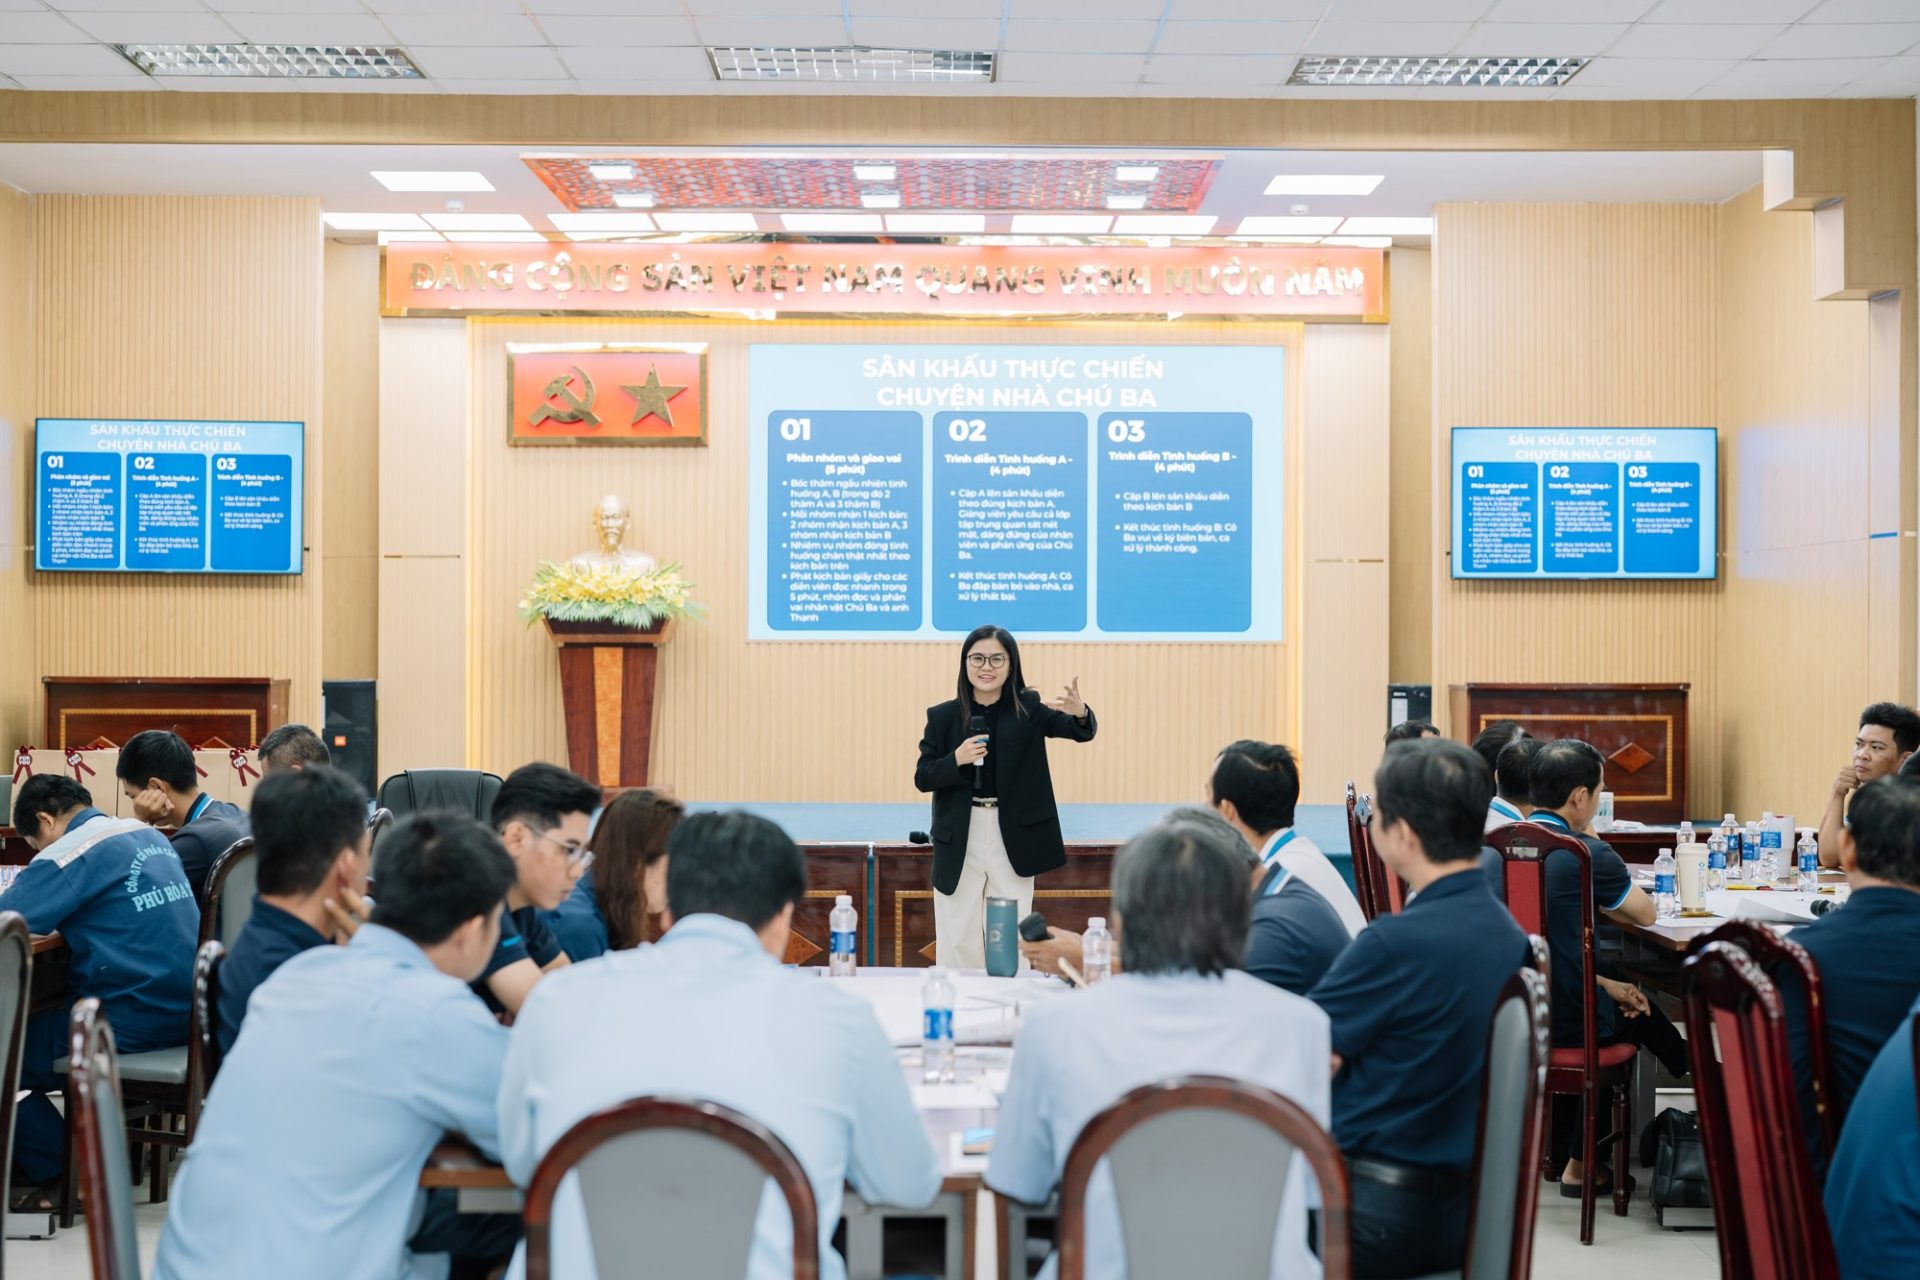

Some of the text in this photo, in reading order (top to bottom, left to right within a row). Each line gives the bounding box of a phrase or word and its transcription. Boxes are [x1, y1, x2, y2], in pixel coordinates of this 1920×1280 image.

[411, 251, 1365, 300] ĐẢNG CỘNG SẢN VIỆT NAM QUANG VINH MUÔN NĂM
[863, 353, 1163, 382] SÂN KHẤU THỰC CHIẾN
[877, 383, 1157, 410] CHUYỆN NHÀ CHÚ BA
[780, 418, 811, 441] 01
[949, 419, 987, 442] 02
[1108, 419, 1145, 443] 03
[47, 455, 63, 468] 01
[134, 456, 154, 469] 02
[787, 453, 901, 464] Phân nhóm và giao vai
[945, 453, 1066, 465] Trình diễn Tình huống A
[1109, 450, 1230, 462] Trình diễn Tình huống B
[216, 457, 237, 470] 03
[825, 464, 865, 475] (5 phút)
[1155, 463, 1195, 473] (4 phút)
[990, 466, 1030, 476] (4 phút)
[1468, 465, 1484, 478] 01
[1550, 465, 1570, 478] 02
[1628, 465, 1647, 478] 03
[132, 886, 165, 911] PHÚ
[163, 880, 188, 902] HÒA
